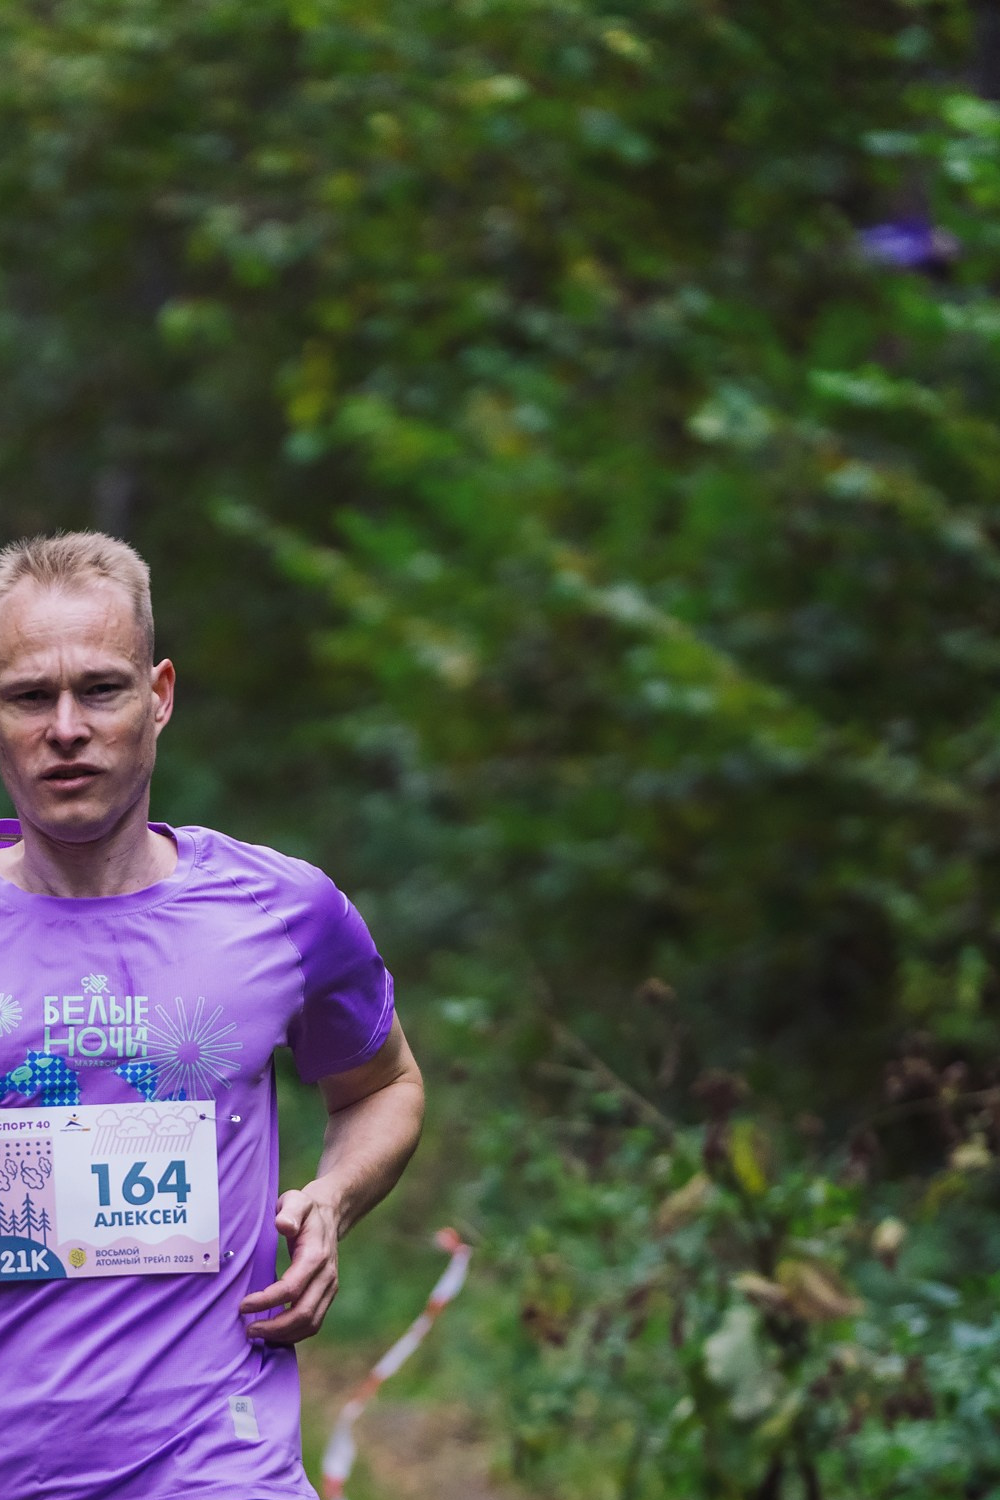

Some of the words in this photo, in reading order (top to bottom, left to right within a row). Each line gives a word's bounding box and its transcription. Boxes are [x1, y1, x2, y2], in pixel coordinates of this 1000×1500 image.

[43, 995, 149, 1025] БЕЛЫЕ
[43, 1026, 148, 1057] НОЧИ
[36, 1120, 50, 1129] 40
[90, 1160, 191, 1207] 164
[93, 1206, 187, 1228] АЛЕКСЕЙ
[95, 1246, 140, 1257] ВОСЬМОЙ
[95, 1255, 141, 1267] АТОМНЫЙ
[143, 1254, 171, 1264] ТРЕЙЛ
[173, 1255, 194, 1263] 2025
